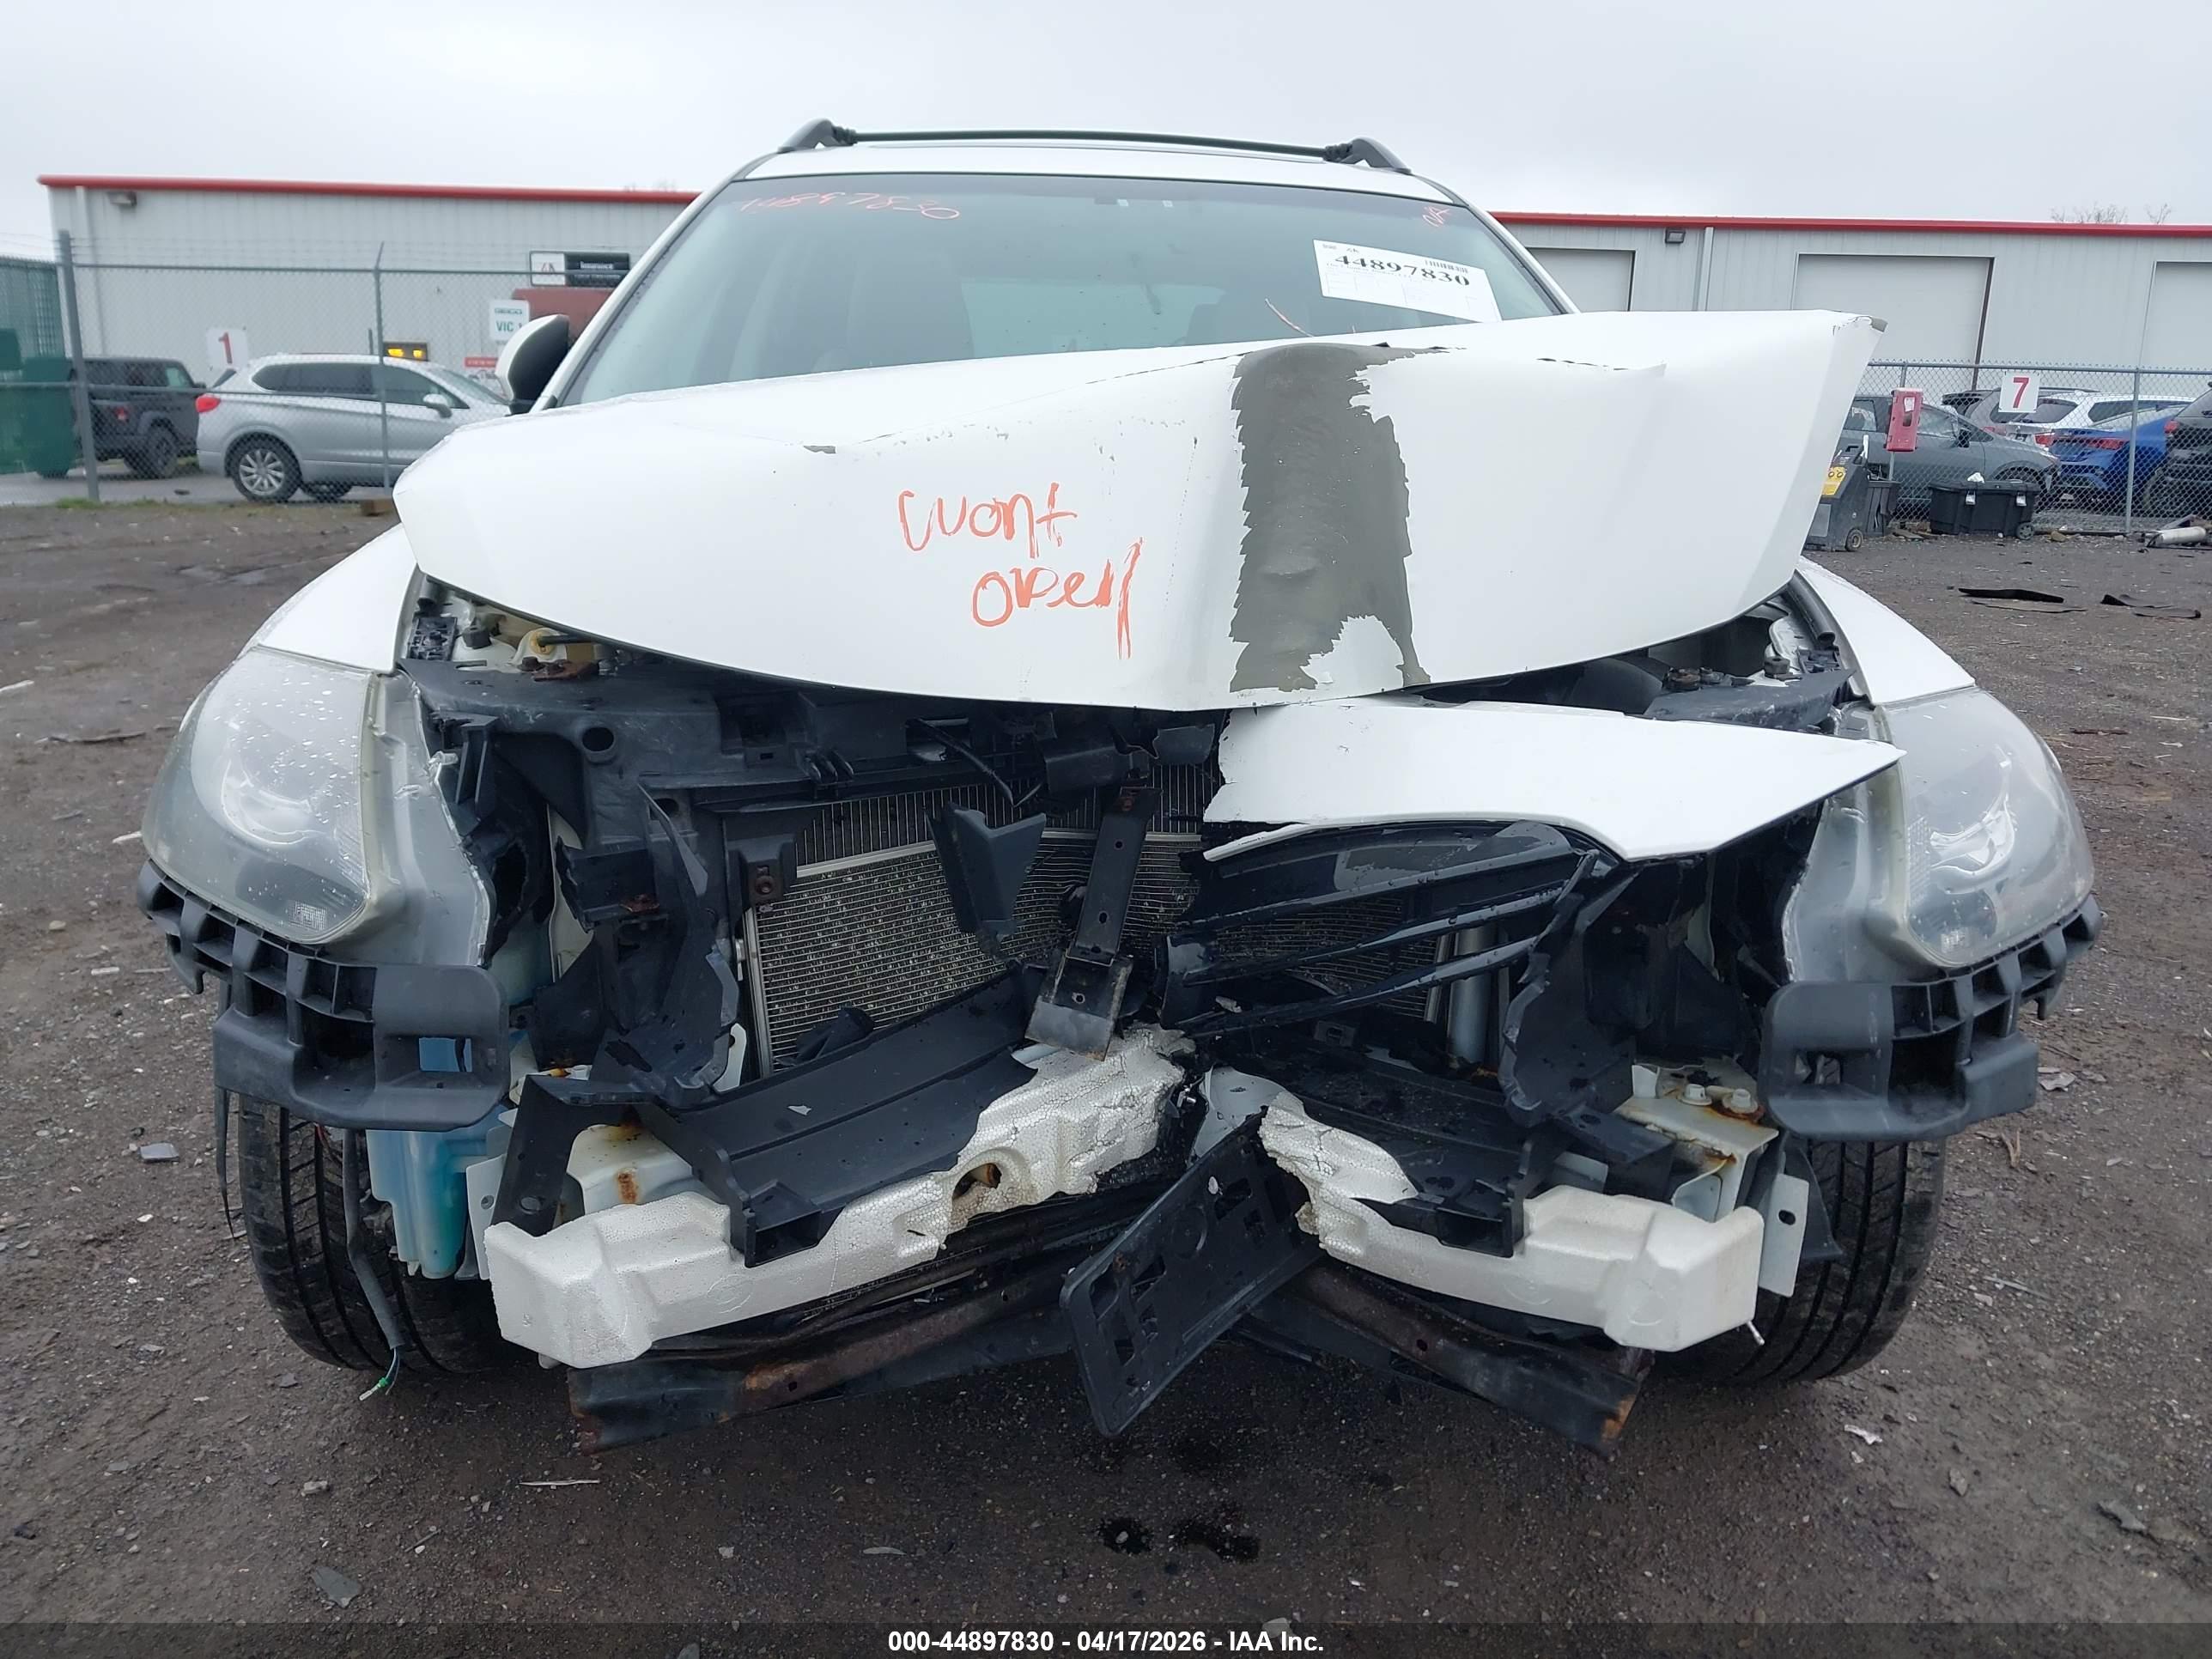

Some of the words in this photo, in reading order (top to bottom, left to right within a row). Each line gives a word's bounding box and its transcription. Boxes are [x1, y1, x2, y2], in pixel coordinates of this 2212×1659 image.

[1334, 256, 1470, 286] 44897830
[495, 320, 514, 332] VIC
[218, 331, 233, 364] 1
[2012, 377, 2030, 409] 7
